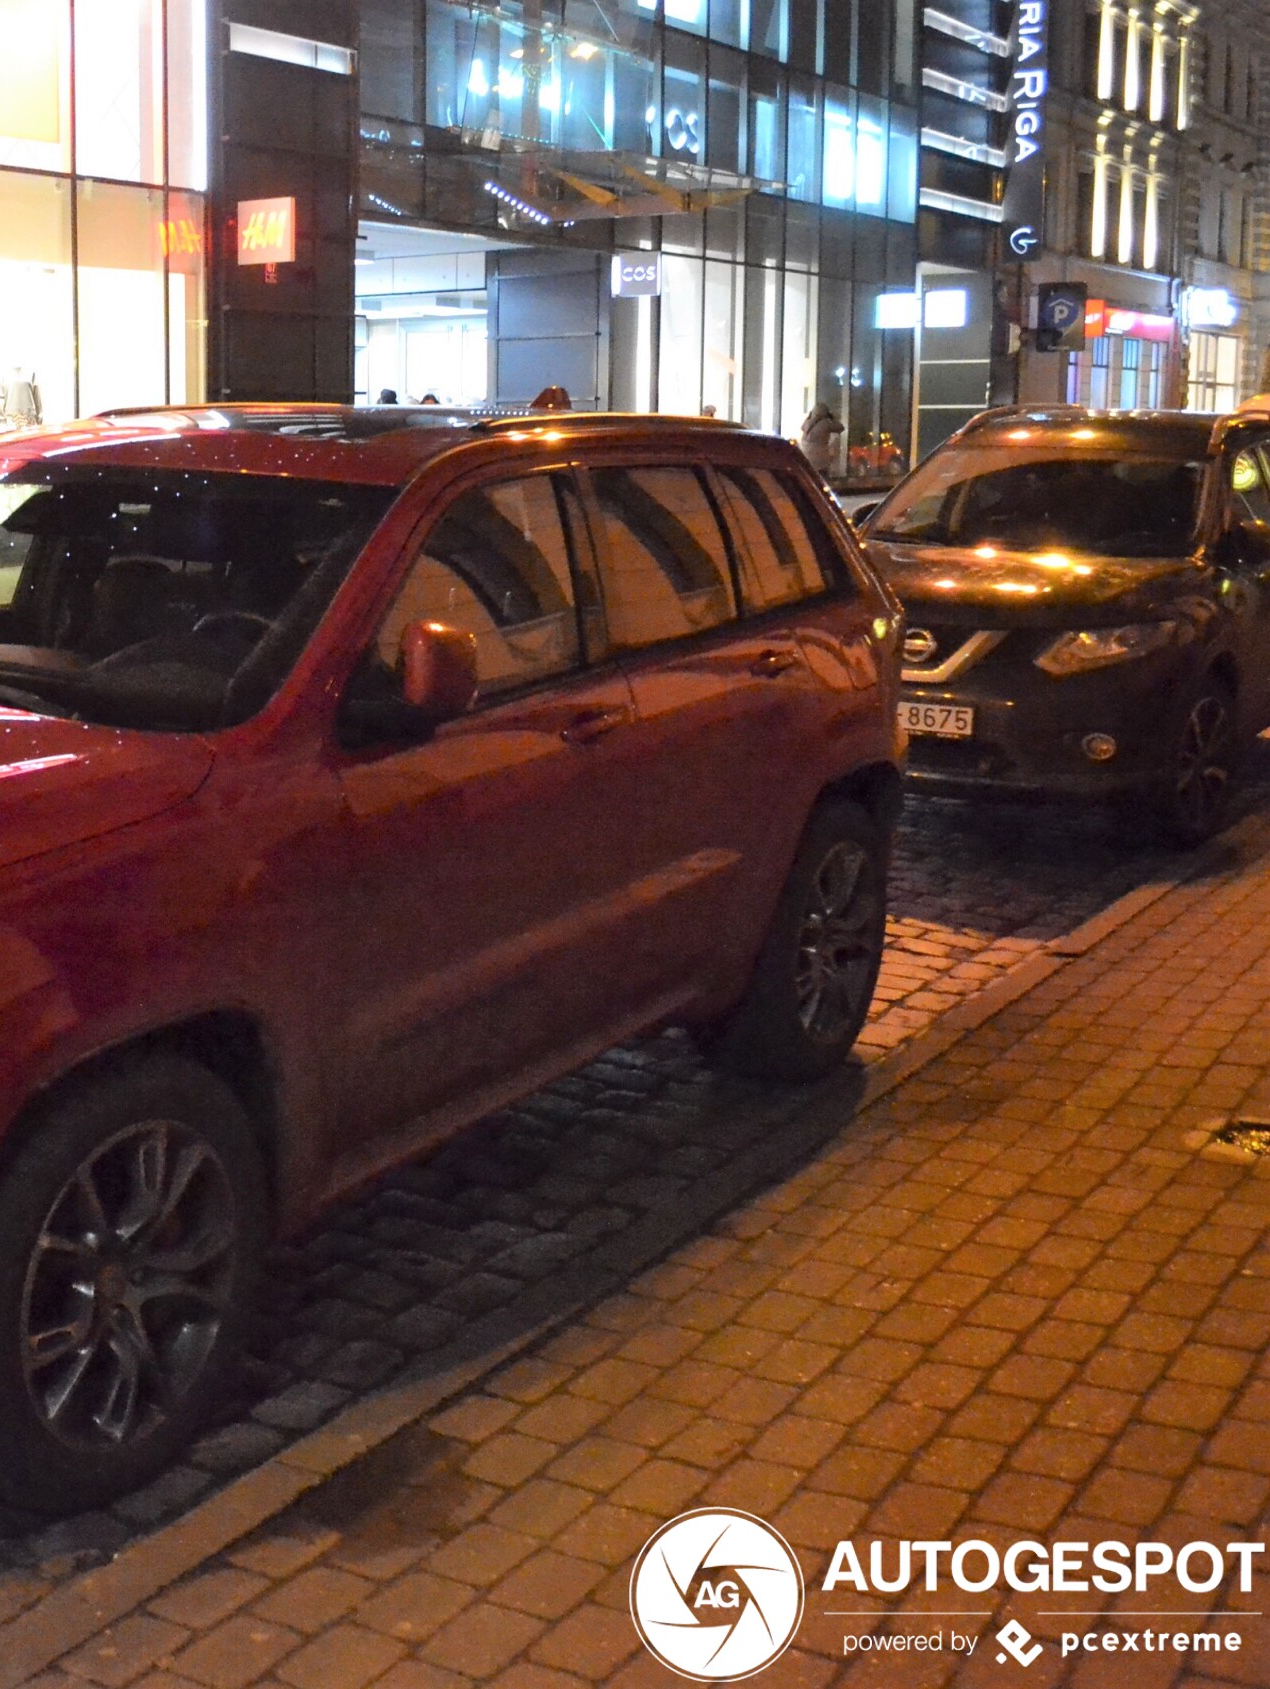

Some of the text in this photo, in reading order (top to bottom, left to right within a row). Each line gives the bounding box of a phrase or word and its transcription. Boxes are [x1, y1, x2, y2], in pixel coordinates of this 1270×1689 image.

[1013, 69, 1046, 163] RIGA
[242, 210, 288, 251] H&M
[622, 265, 657, 282] COS
